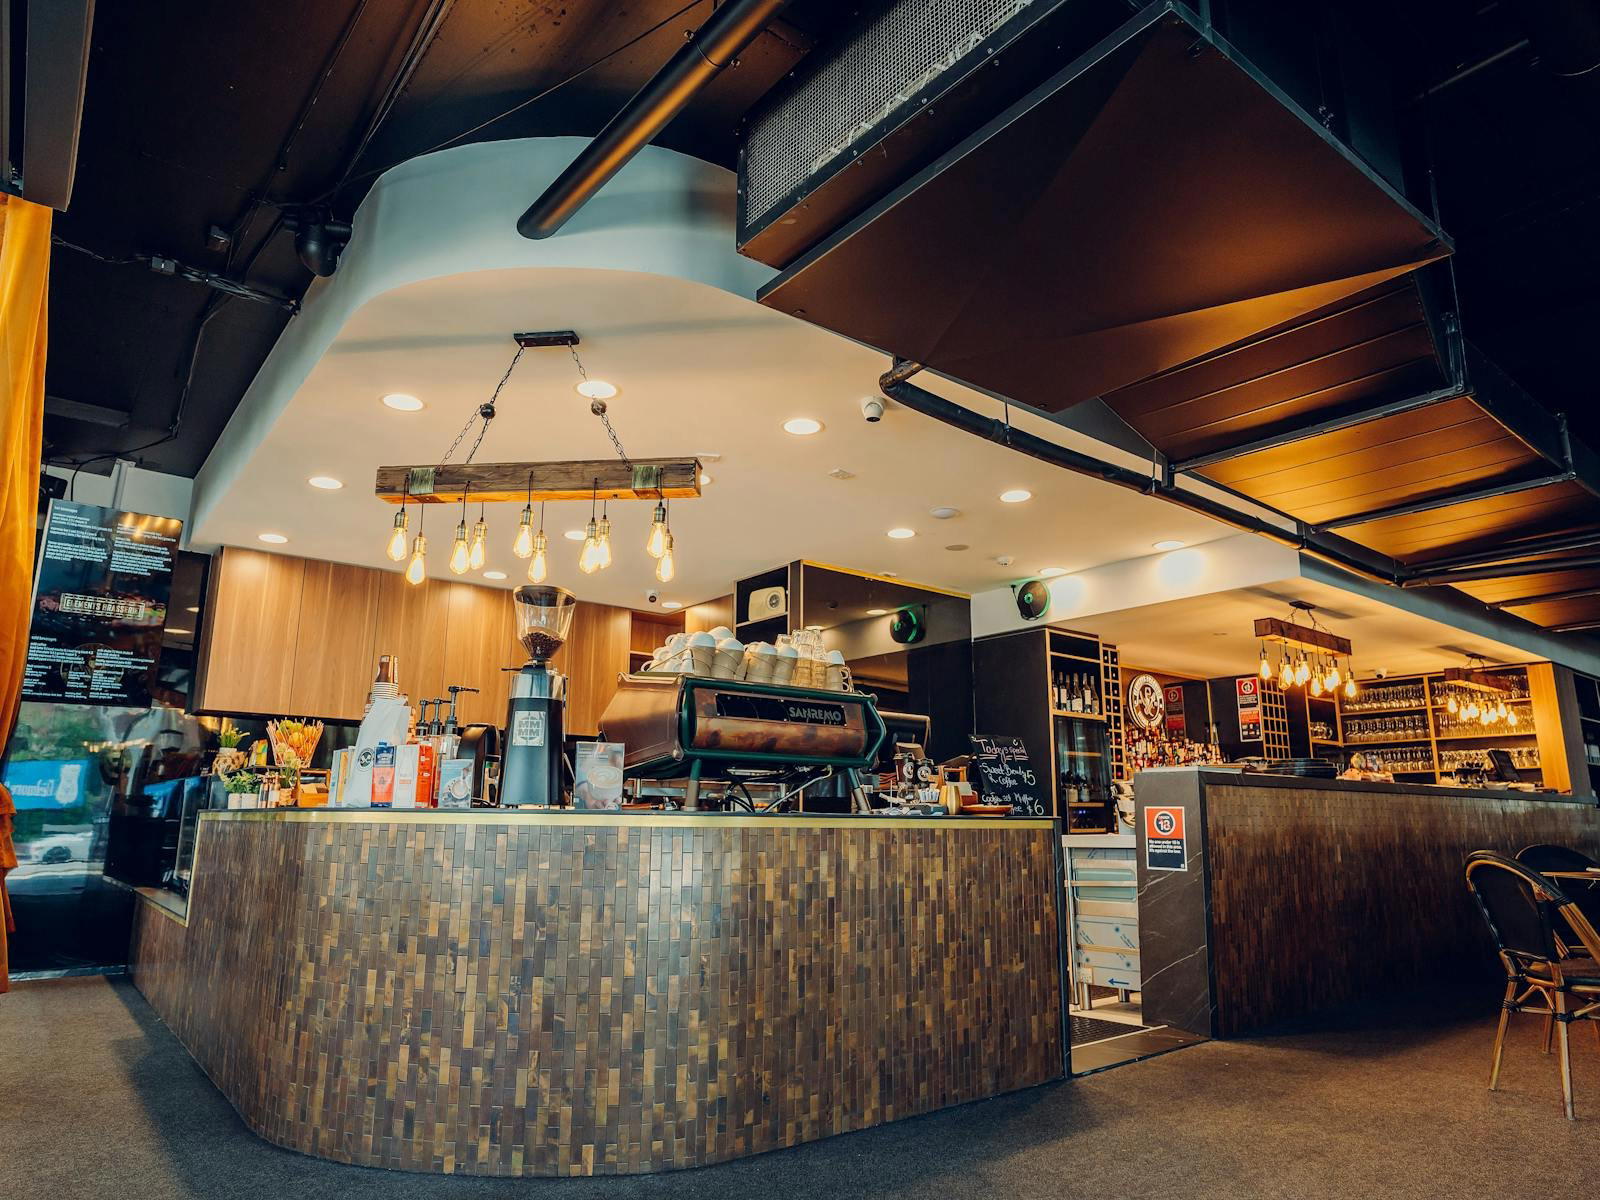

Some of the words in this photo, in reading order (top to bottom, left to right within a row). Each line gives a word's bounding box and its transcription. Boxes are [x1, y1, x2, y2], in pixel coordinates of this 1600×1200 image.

[66, 599, 101, 611] ELEMENTS
[102, 603, 140, 616] BRASSERIE
[789, 706, 842, 721] SANREMO
[982, 763, 1005, 776] Sweet
[999, 776, 1019, 788] Coffee
[1158, 820, 1171, 831] 18
